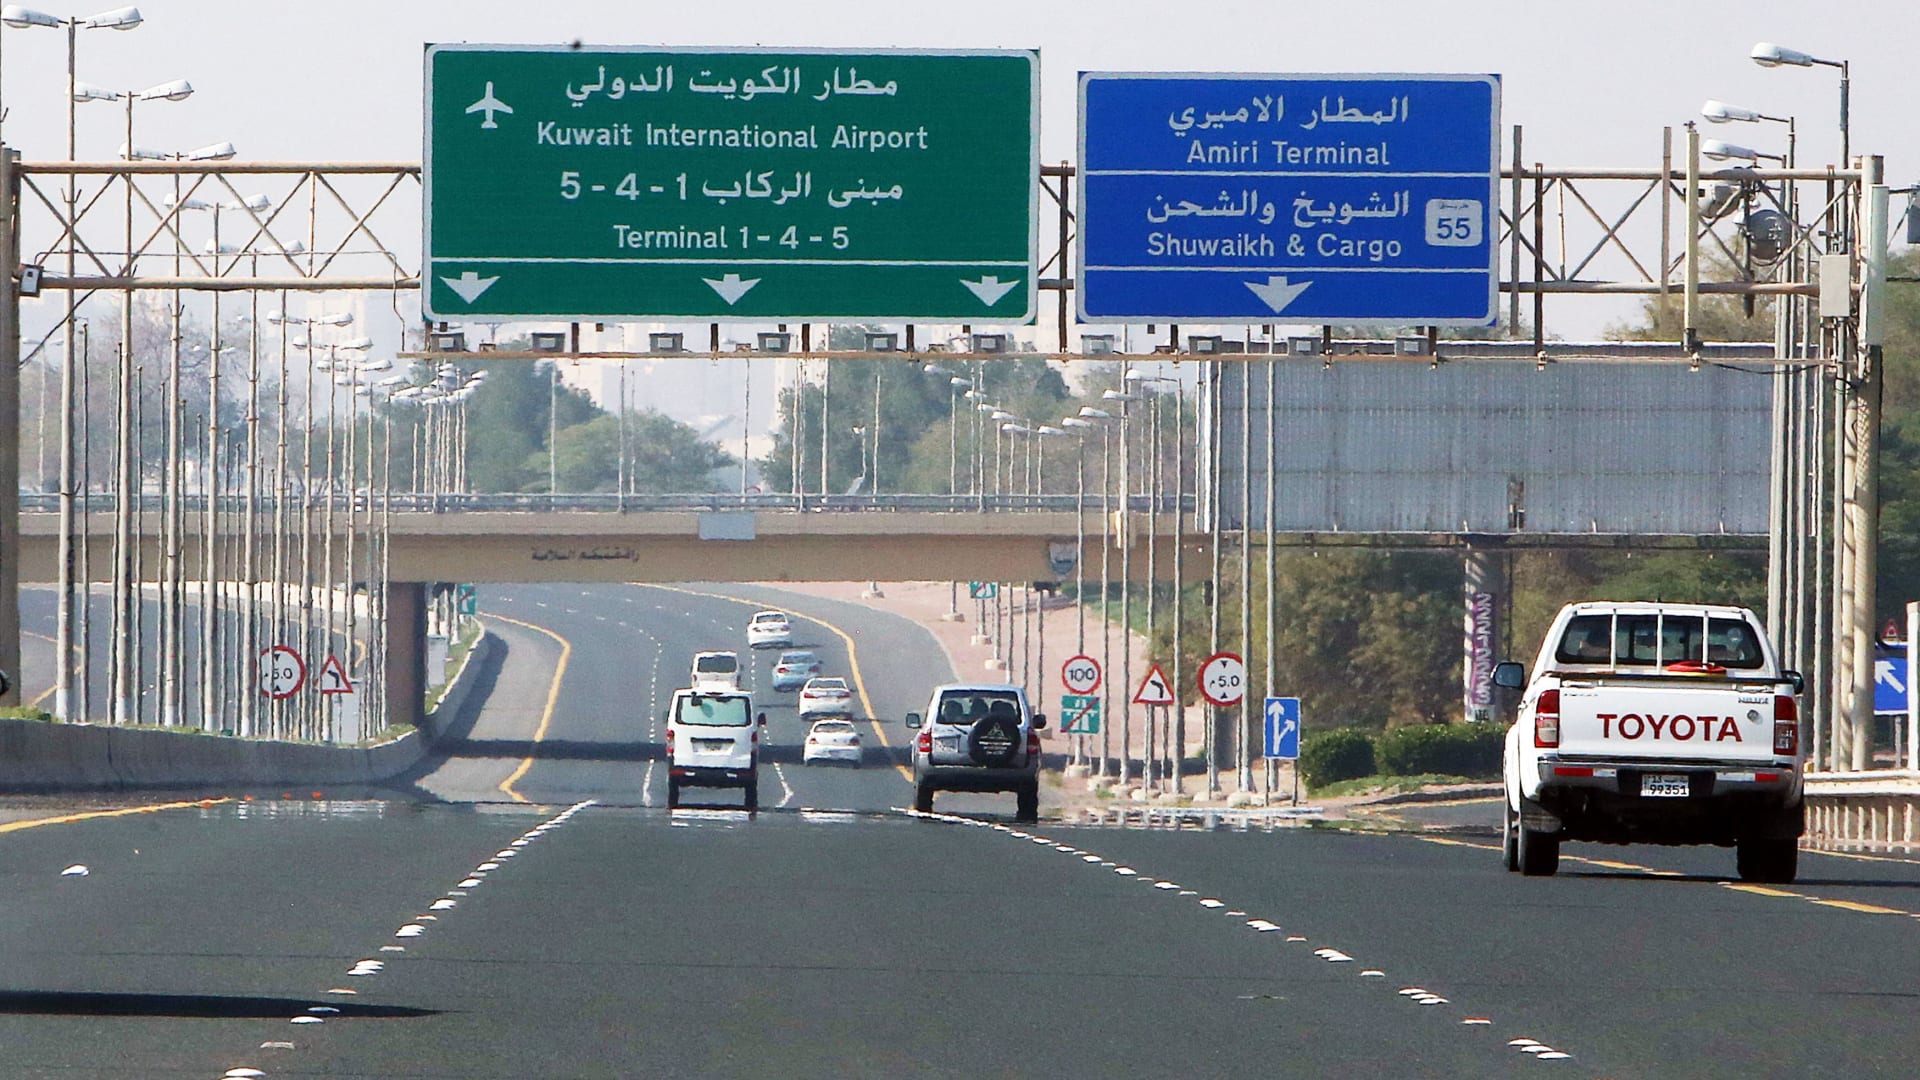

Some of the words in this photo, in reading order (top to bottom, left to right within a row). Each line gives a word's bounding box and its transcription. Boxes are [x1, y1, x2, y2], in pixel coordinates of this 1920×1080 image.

[566, 65, 673, 108] الدولي
[689, 65, 800, 101] الكويت
[813, 67, 898, 101] مطار
[1300, 96, 1408, 130] المطار
[537, 121, 632, 146] Kuwait
[646, 123, 818, 149] International
[831, 125, 928, 153] Airport
[1187, 139, 1258, 164] Amiri
[1271, 140, 1390, 166] Terminal
[561, 171, 581, 200] 5
[615, 173, 640, 201] 4
[676, 173, 687, 200] 1
[702, 170, 811, 205] الركاب
[827, 179, 903, 208] مبنى
[1147, 189, 1275, 225] والشحن
[1292, 190, 1409, 228] الشويخ
[613, 224, 728, 250] Terminal
[739, 226, 748, 249] 1
[779, 226, 799, 250] 4
[832, 226, 849, 250] 5
[1437, 217, 1471, 240] 55
[1147, 232, 1274, 257] Shuwaikh
[1286, 233, 1305, 257] &
[1317, 233, 1401, 262] Cargo
[1068, 667, 1096, 682] 100
[1218, 674, 1240, 688] 5.0
[1597, 713, 1743, 742] TOYOTA
[1650, 784, 1687, 795] 99351
